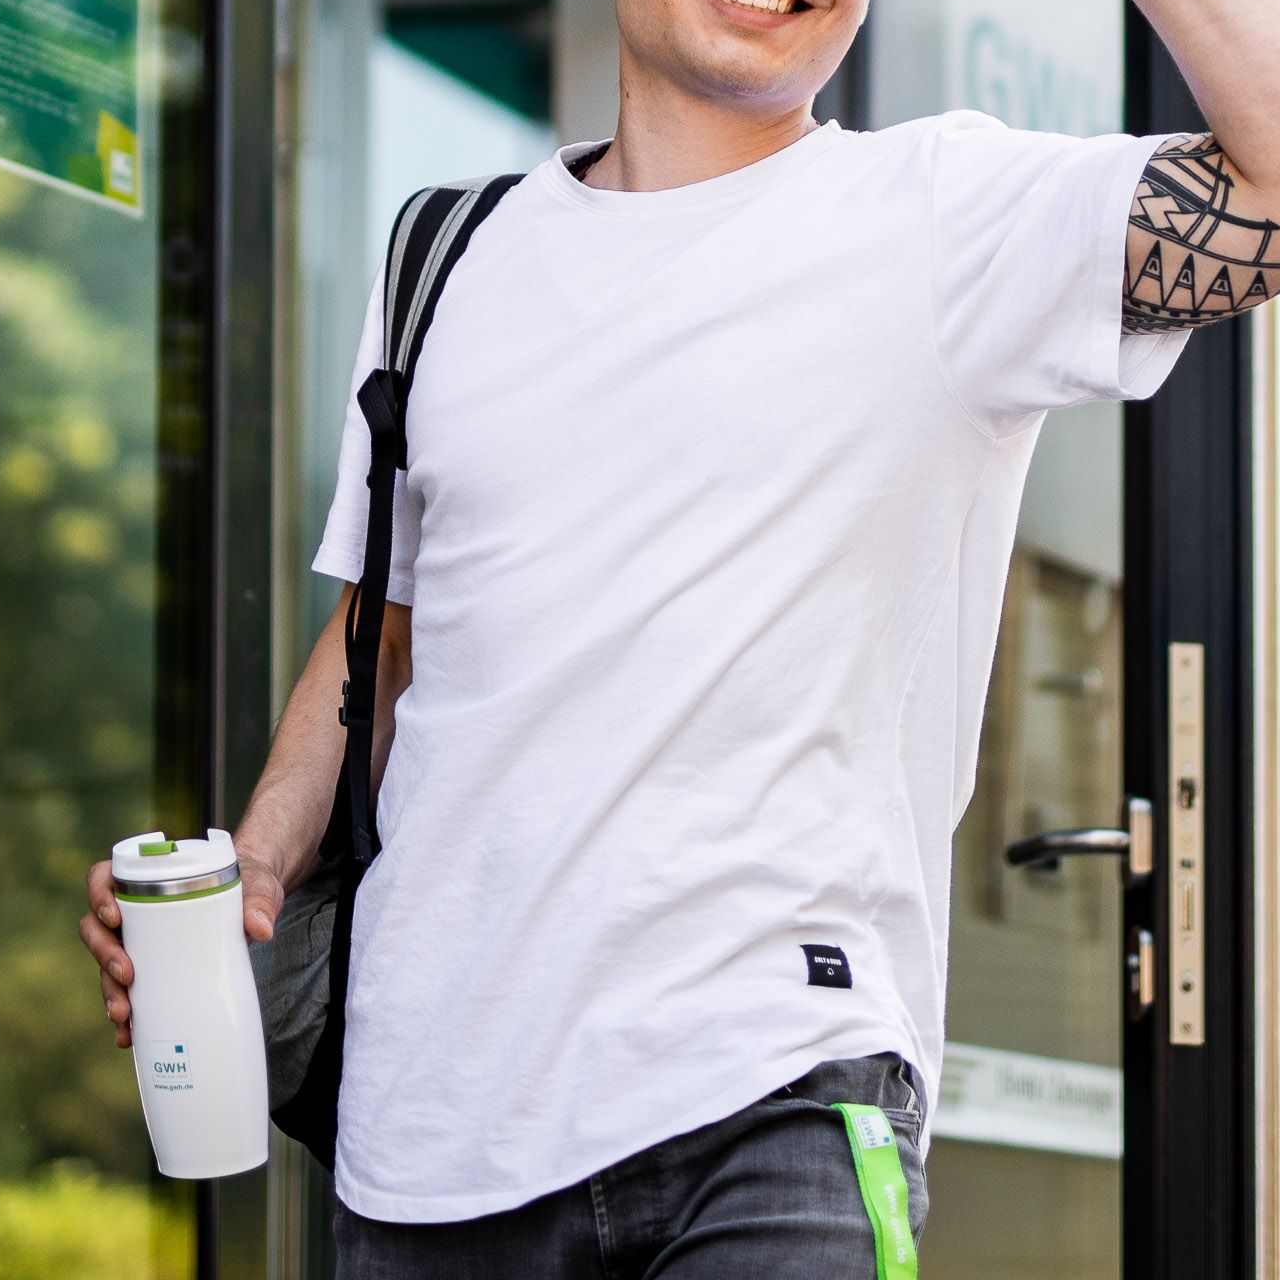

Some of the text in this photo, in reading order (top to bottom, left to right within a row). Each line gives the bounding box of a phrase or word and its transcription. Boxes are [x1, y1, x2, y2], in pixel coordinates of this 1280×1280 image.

[154, 1062, 187, 1073] GWH
[154, 1083, 194, 1092] www.gwh.de
[860, 1116, 878, 1147] GWH
